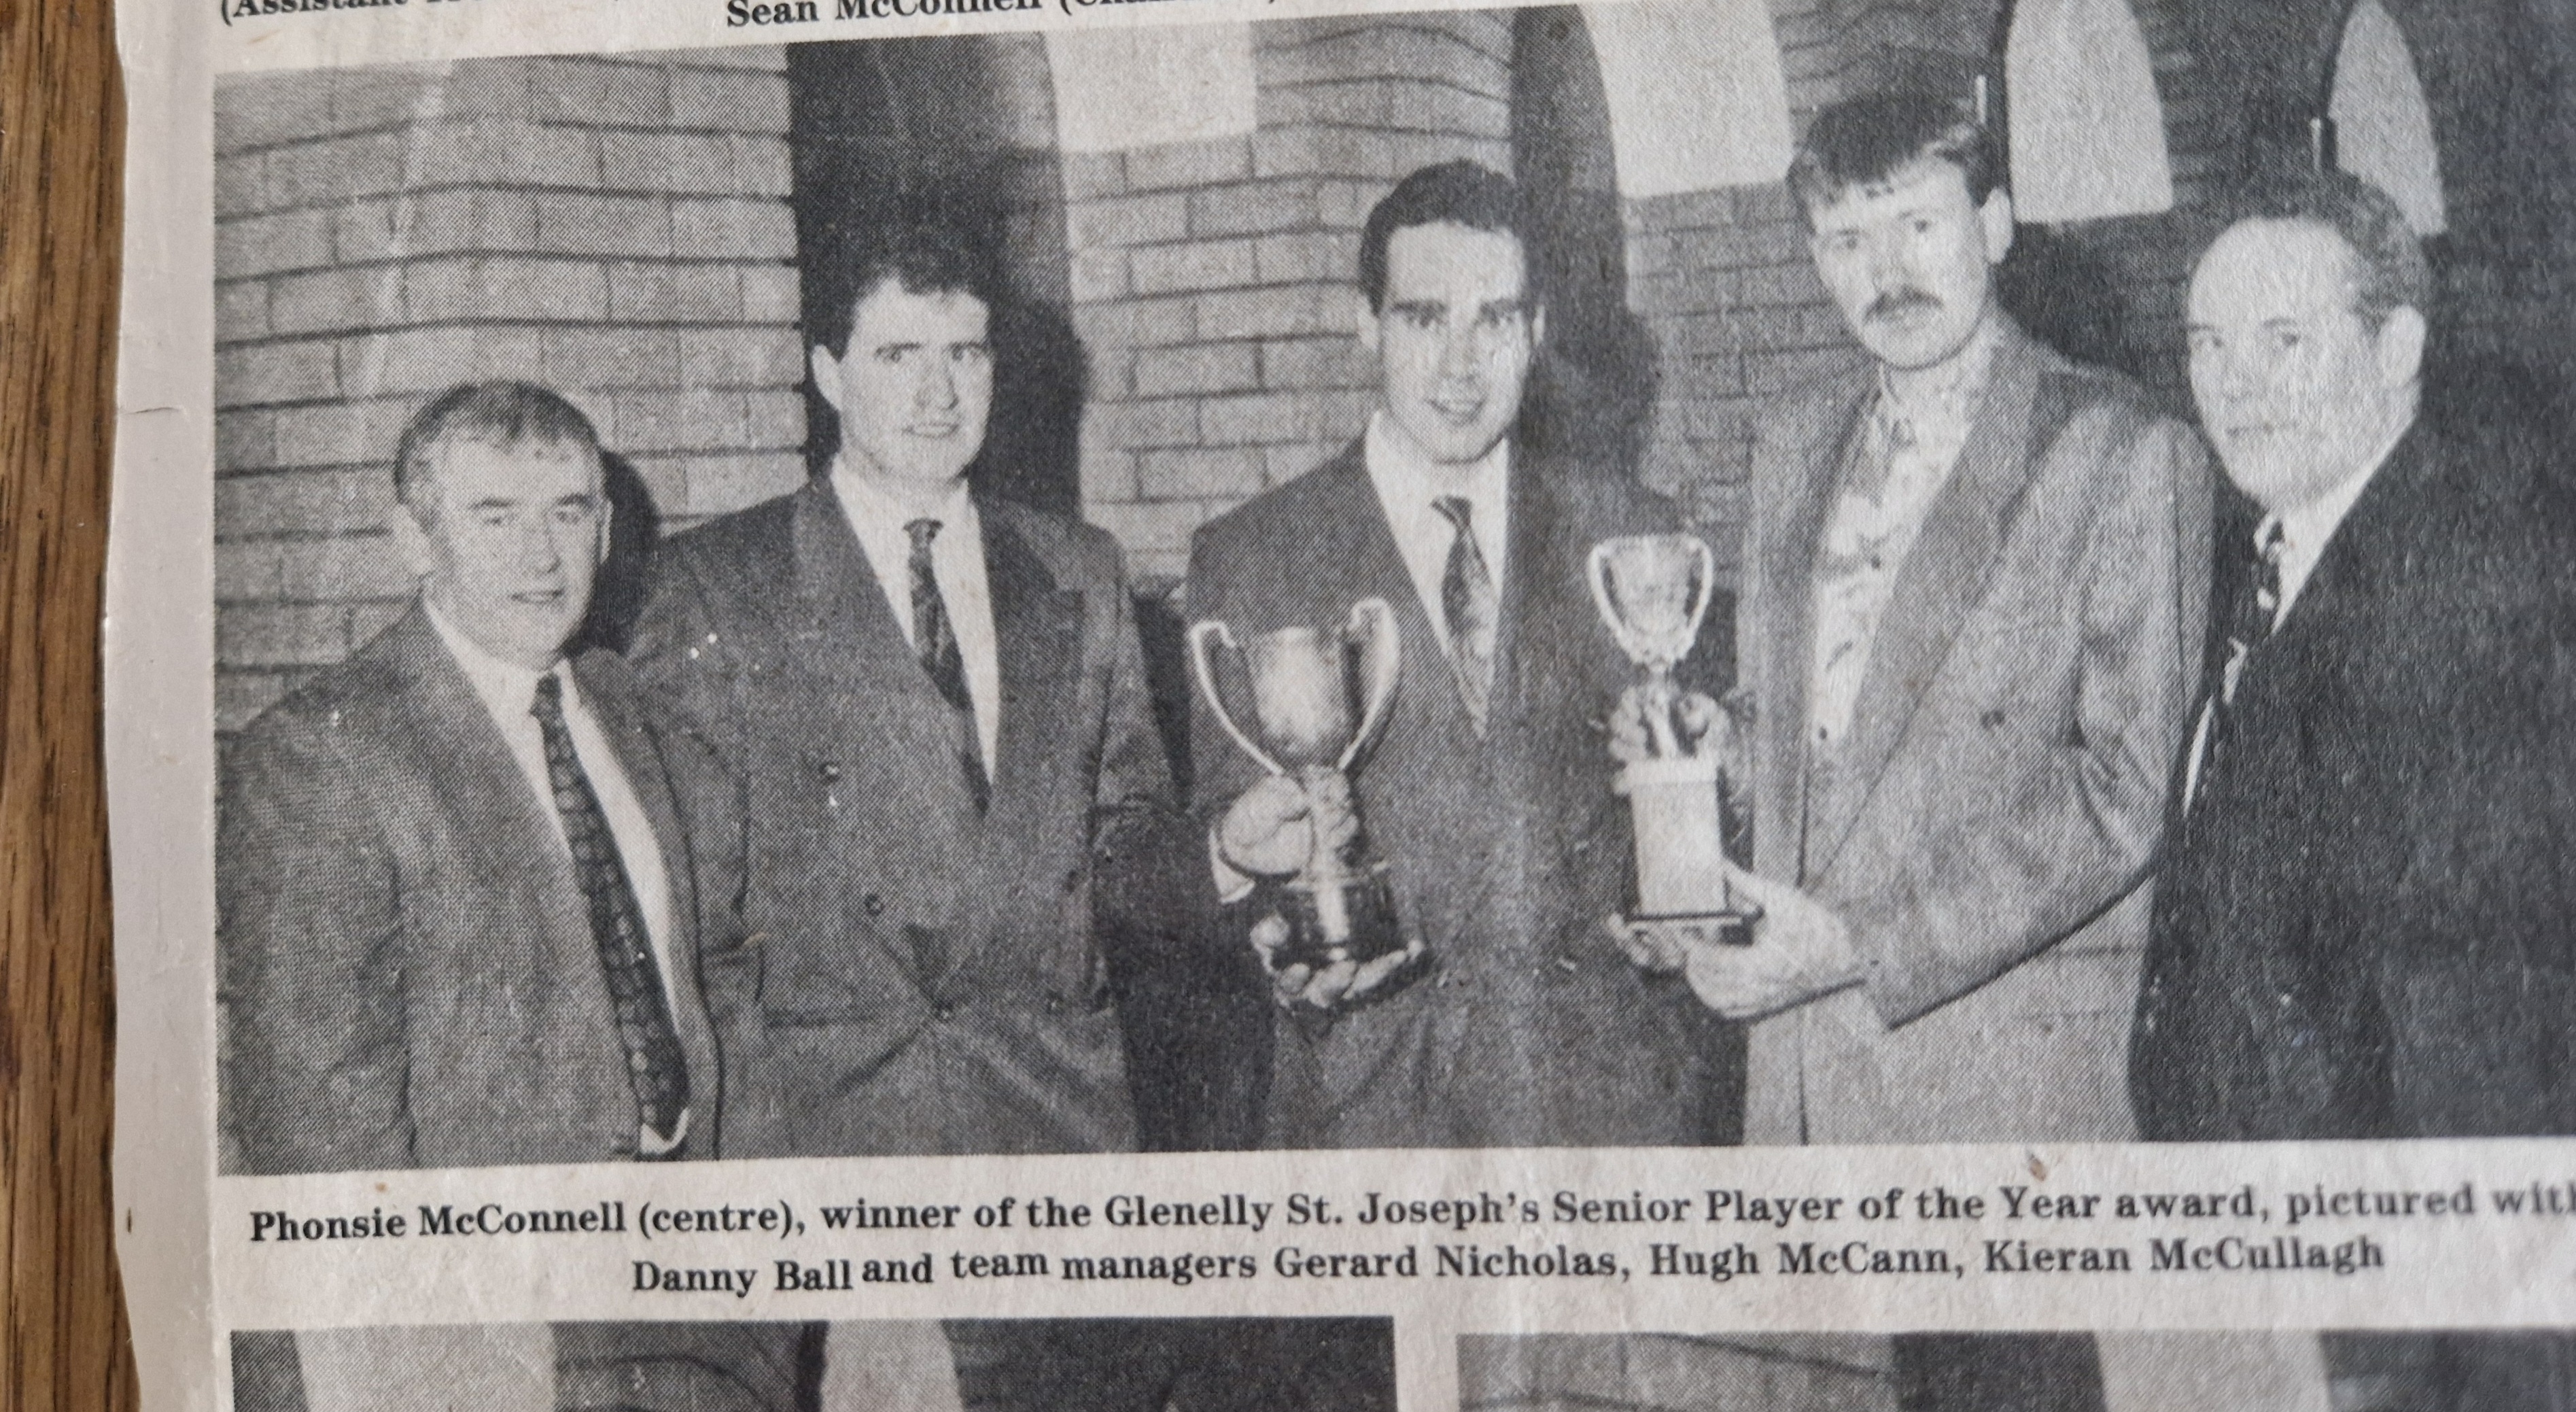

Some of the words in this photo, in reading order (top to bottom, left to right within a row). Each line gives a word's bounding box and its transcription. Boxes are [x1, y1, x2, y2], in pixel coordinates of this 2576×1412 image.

[727, 0, 818, 27] Sean
[249, 1207, 407, 1243] Phonsie
[417, 1201, 627, 1237] McConnell
[638, 1199, 805, 1241] (centre),
[820, 1197, 962, 1230] winner
[973, 1196, 1016, 1228] of
[1025, 1196, 1092, 1228] the
[1104, 1194, 1274, 1233] Glenelly
[1287, 1193, 1343, 1226] St.
[1357, 1192, 1539, 1228] Joseph's
[1553, 1190, 1692, 1224] Senior
[1706, 1190, 1843, 1229] Player
[1858, 1188, 1904, 1220] of
[1915, 1187, 1985, 1221] the
[2000, 1186, 2102, 1220] Year
[2114, 1186, 2269, 1224] award,
[2286, 1183, 2476, 1226] pictured
[631, 1260, 758, 1298] Danny
[773, 1259, 853, 1292] Ball
[862, 1252, 934, 1284] and
[950, 1250, 1050, 1279] team
[1061, 1252, 1257, 1286] managers
[1273, 1245, 1419, 1278] Gerard
[1434, 1244, 1631, 1283] Nicholas,
[1649, 1242, 1760, 1281] Hugh
[1776, 1241, 1964, 1279] McCann,
[1983, 1239, 2132, 1273] Kieran
[2149, 1235, 2384, 1276] McCullagh
